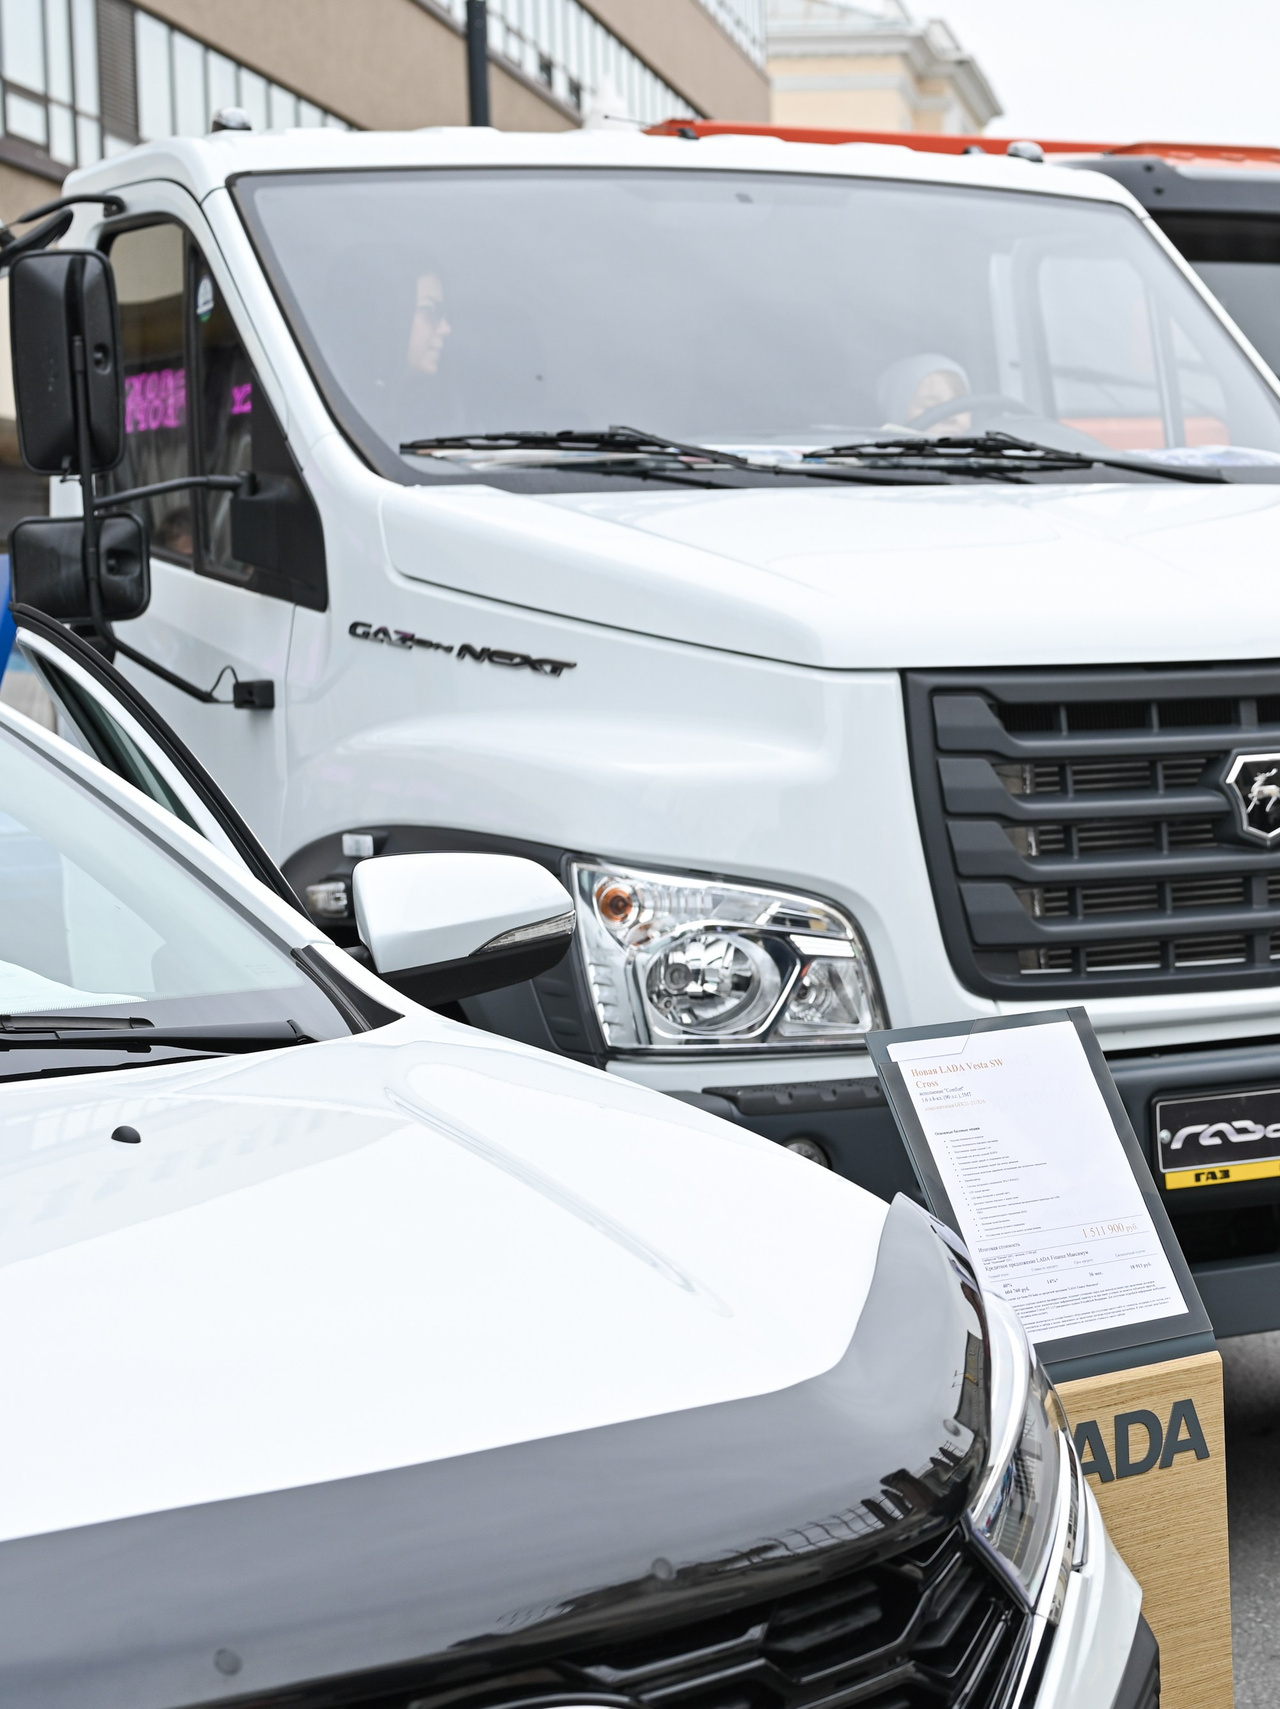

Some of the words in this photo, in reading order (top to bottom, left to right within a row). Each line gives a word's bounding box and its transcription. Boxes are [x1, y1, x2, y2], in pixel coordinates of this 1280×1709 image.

[910, 1067, 938, 1077] Новая
[939, 1063, 965, 1074] LADA
[966, 1061, 989, 1070] Vesta
[989, 1058, 1004, 1068] SW
[915, 1080, 939, 1089] Cross
[1194, 1168, 1231, 1183] ГАЗ
[1089, 1225, 1106, 1237] 511
[1107, 1222, 1125, 1234] 900
[1072, 1398, 1211, 1483] ADA
